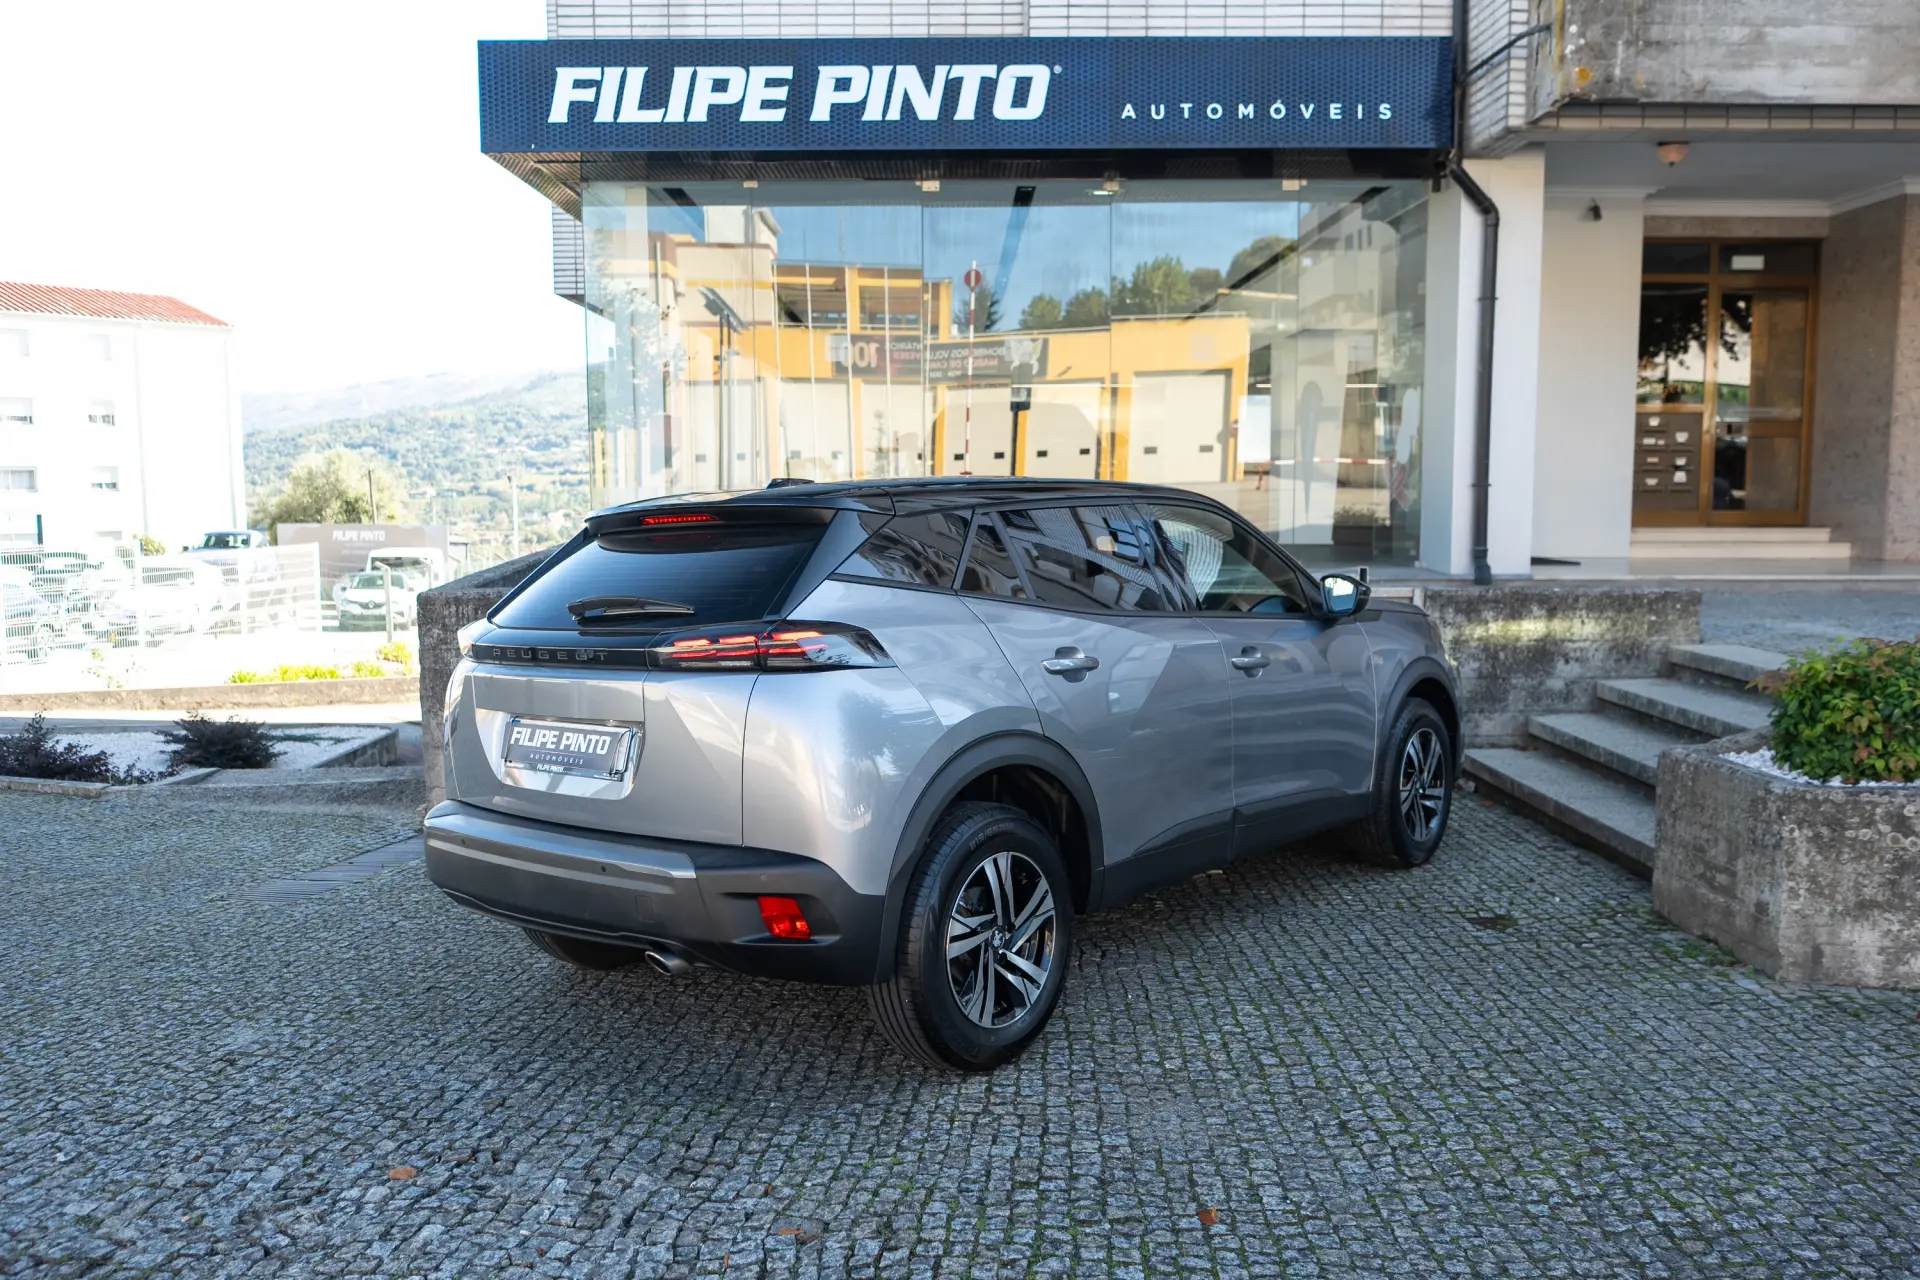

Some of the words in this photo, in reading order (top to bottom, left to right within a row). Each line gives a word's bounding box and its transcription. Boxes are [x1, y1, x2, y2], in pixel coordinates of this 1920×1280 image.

[548, 65, 793, 124] FILIPE
[809, 65, 1051, 122] PINTO
[1121, 100, 1392, 119] AUTOMÓVEIS
[492, 648, 608, 661] PEUGEOT
[510, 727, 559, 750] FILIPE
[559, 732, 611, 755] PINTO
